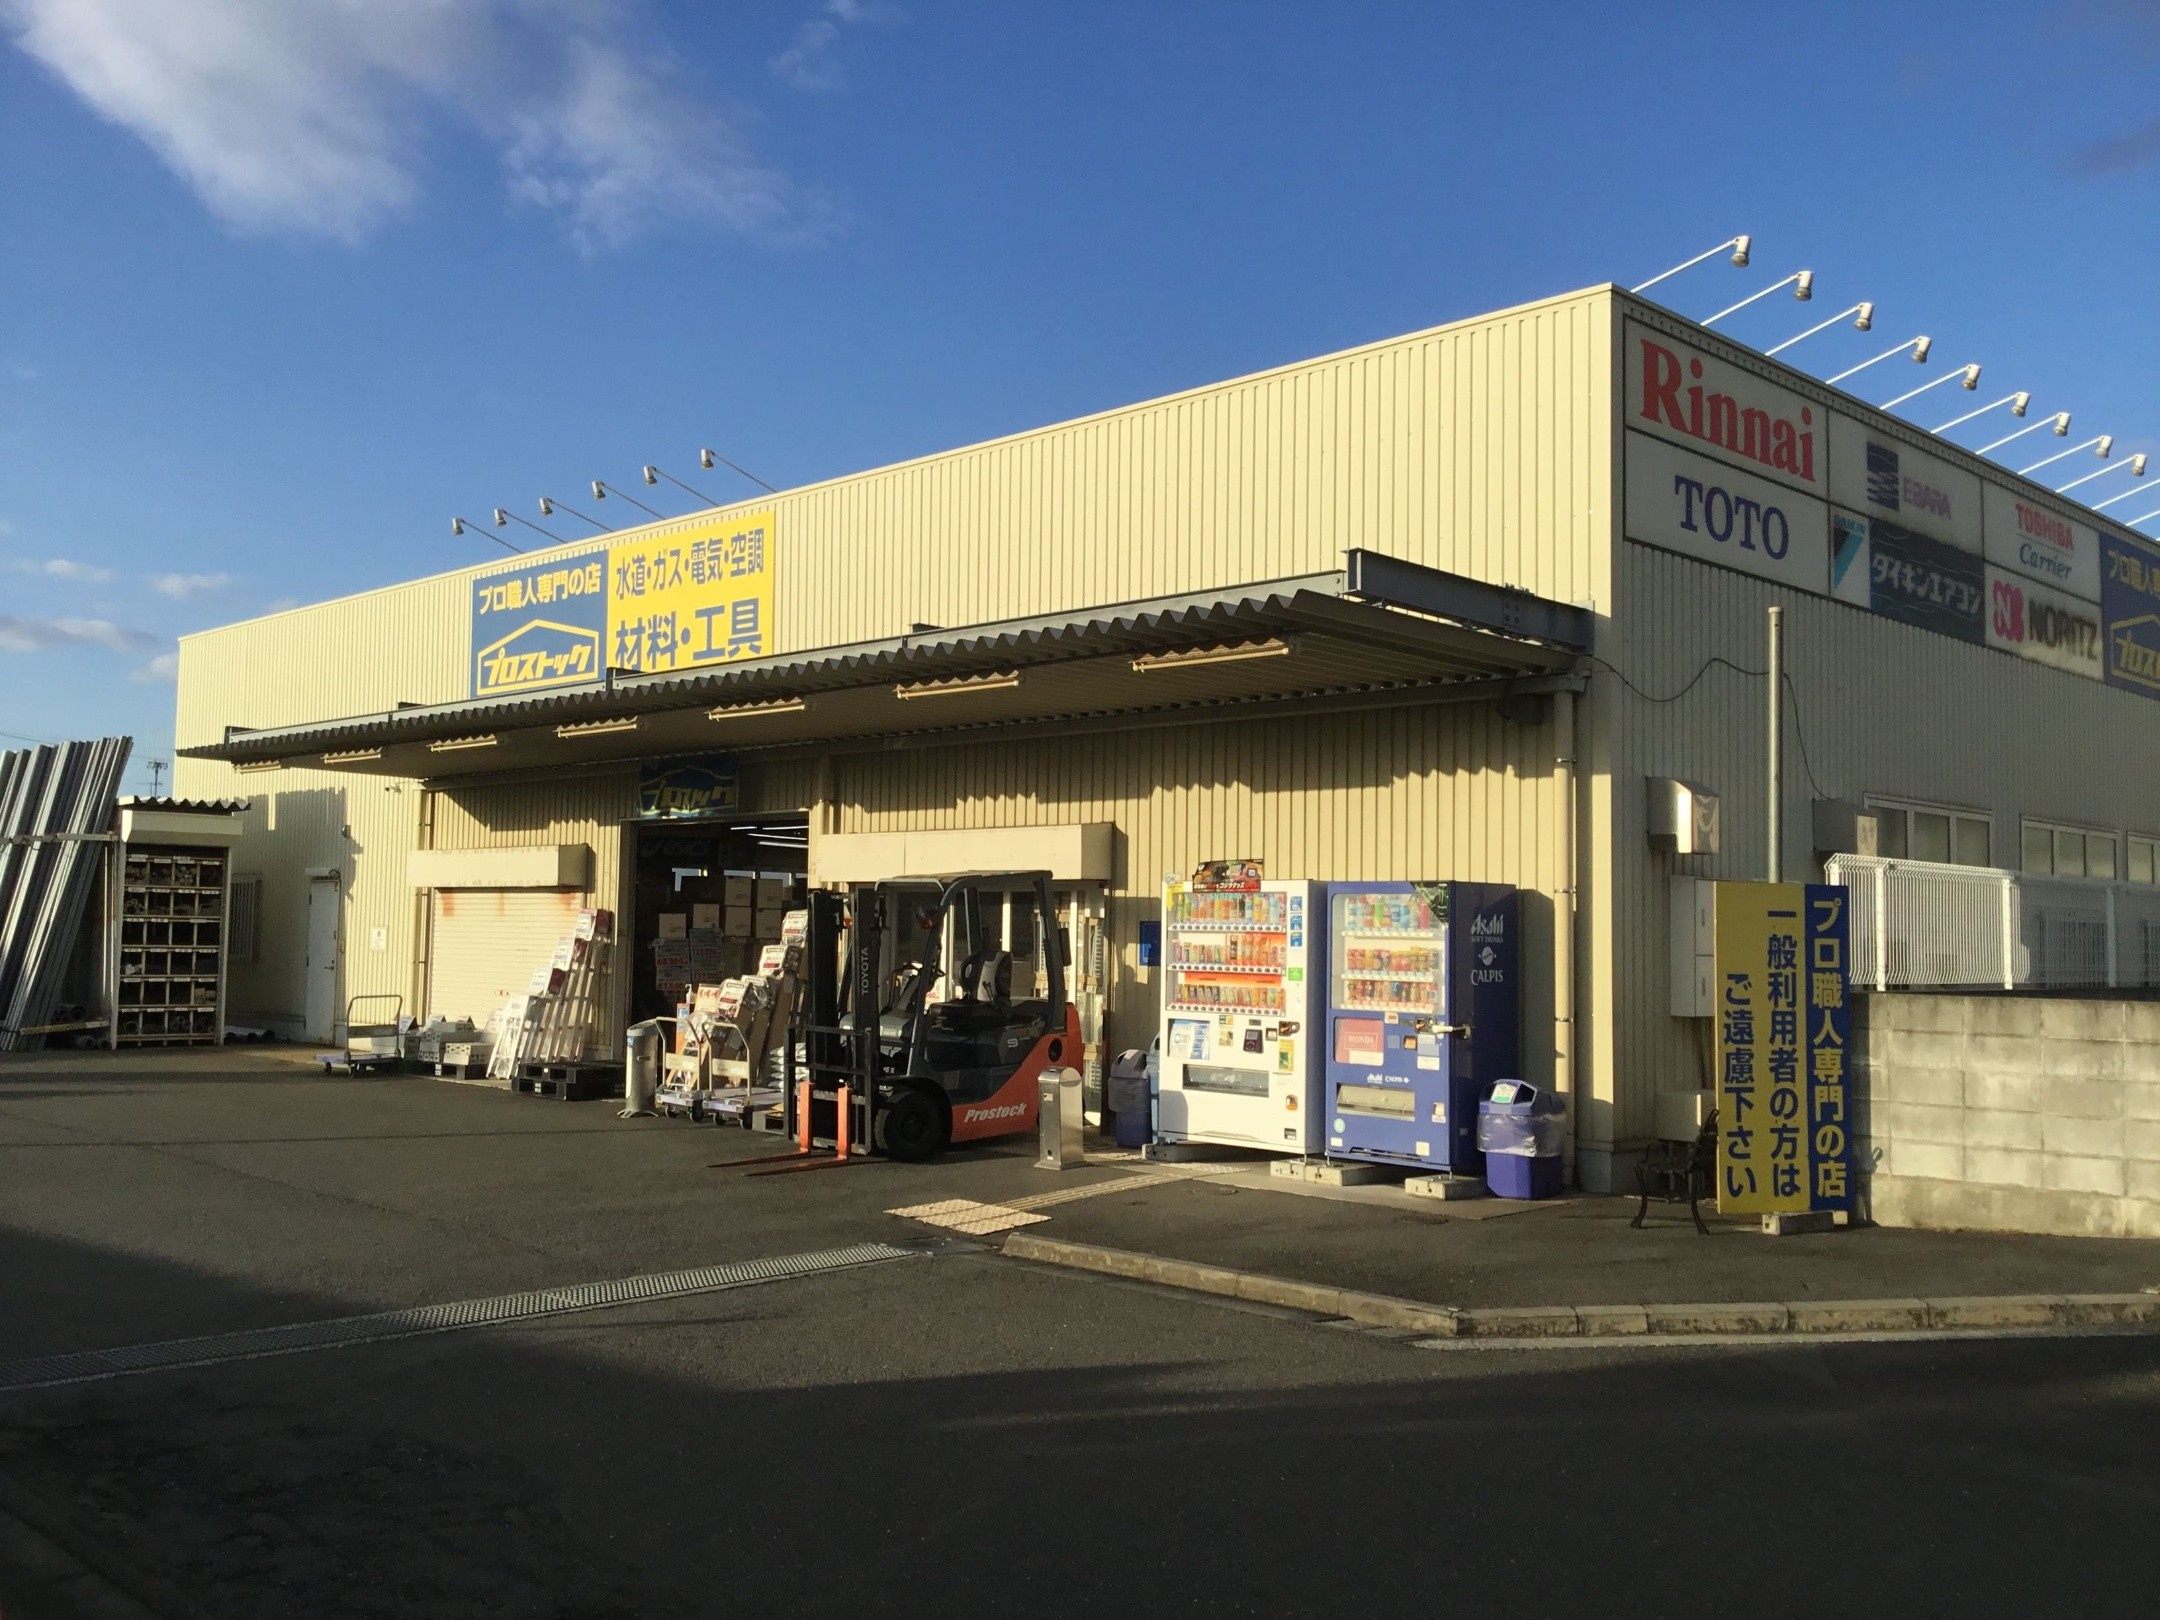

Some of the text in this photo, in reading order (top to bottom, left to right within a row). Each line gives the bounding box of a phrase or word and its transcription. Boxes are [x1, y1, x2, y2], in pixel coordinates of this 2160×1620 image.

[1640, 338, 1816, 482] Rinnai
[1674, 474, 1790, 560] TOTO
[2015, 503, 2074, 550] TOSHIBA
[615, 528, 764, 600] 水道・ガス・電気・空調
[2019, 542, 2073, 581] Carrier
[479, 563, 602, 614] プロ職人専門の店
[615, 597, 762, 670] 材料・工具
[484, 643, 592, 686] プロストック
[1470, 913, 1504, 935] Asahi
[861, 947, 869, 995] TOYOTA
[1470, 969, 1504, 986] CALPIS
[1767, 910, 1800, 1197] 一般利用者の方は
[1812, 898, 1847, 1198] プロ職人専門の店
[1724, 974, 1756, 1198] ご遠慮下さい
[964, 1103, 1027, 1123] Prostock
